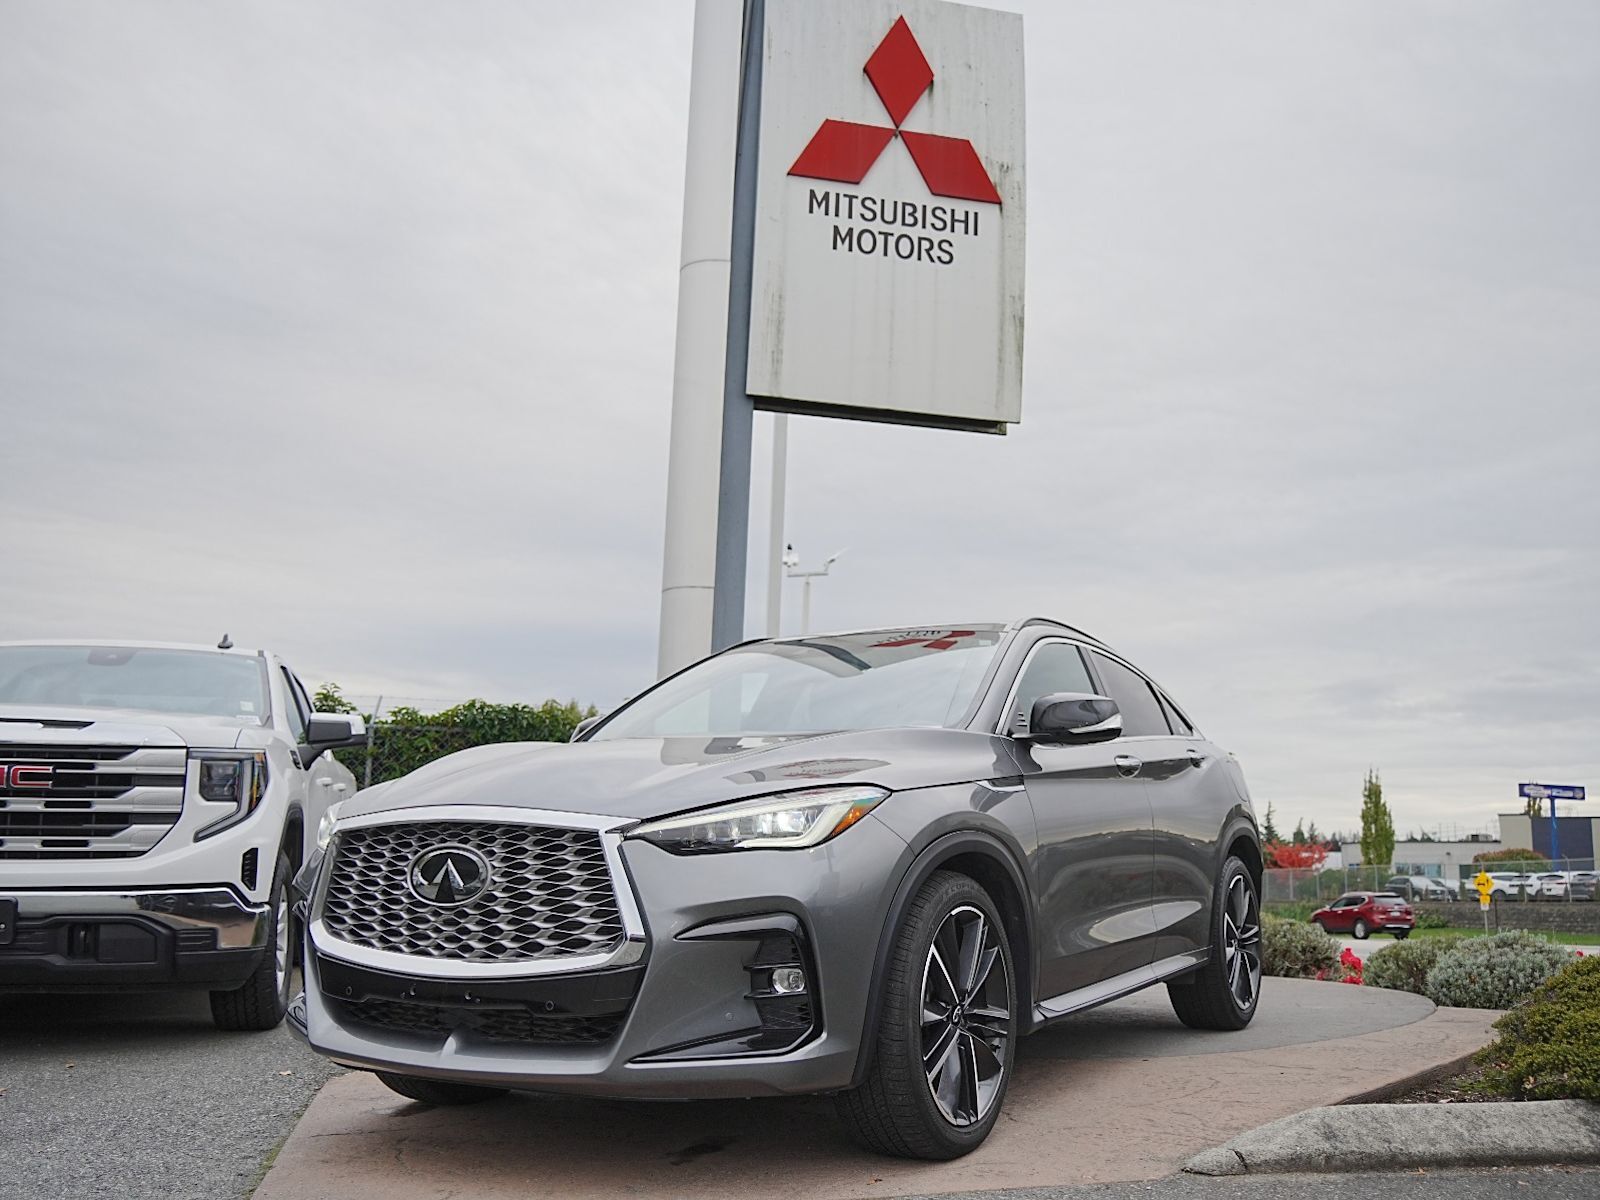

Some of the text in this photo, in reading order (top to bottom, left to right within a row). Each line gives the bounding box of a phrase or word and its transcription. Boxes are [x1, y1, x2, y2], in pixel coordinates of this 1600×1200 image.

[808, 188, 979, 237] MITSUBISHI
[832, 224, 954, 265] MOTORS
[0, 765, 53, 788] C
